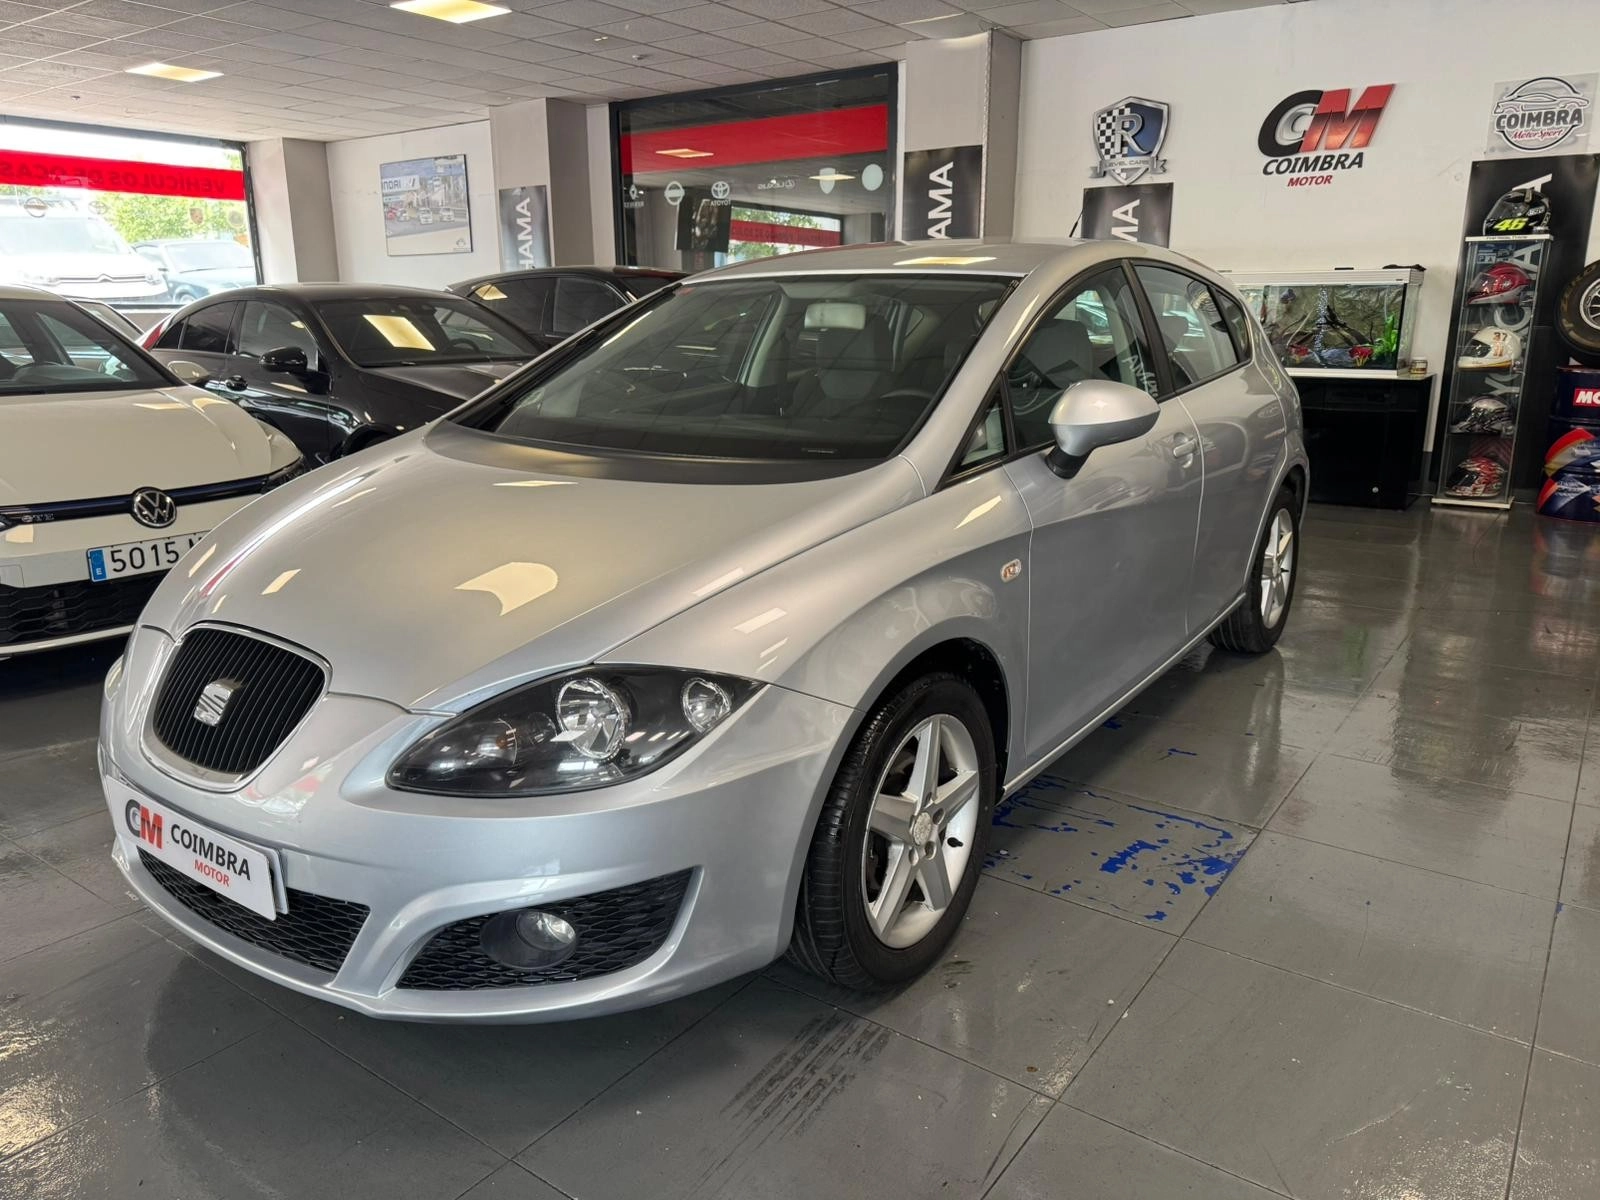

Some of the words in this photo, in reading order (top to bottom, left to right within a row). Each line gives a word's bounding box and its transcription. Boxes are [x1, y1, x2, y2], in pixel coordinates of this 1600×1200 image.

[1495, 108, 1583, 131] COIMBRA
[1262, 152, 1363, 176] COIMBRA
[1287, 175, 1333, 187] MOTOR
[1494, 217, 1529, 231] 46
[110, 541, 180, 573] 5015
[95, 567, 103, 576] E
[170, 823, 252, 882] COIMBRA
[194, 859, 231, 887] MOTOR
